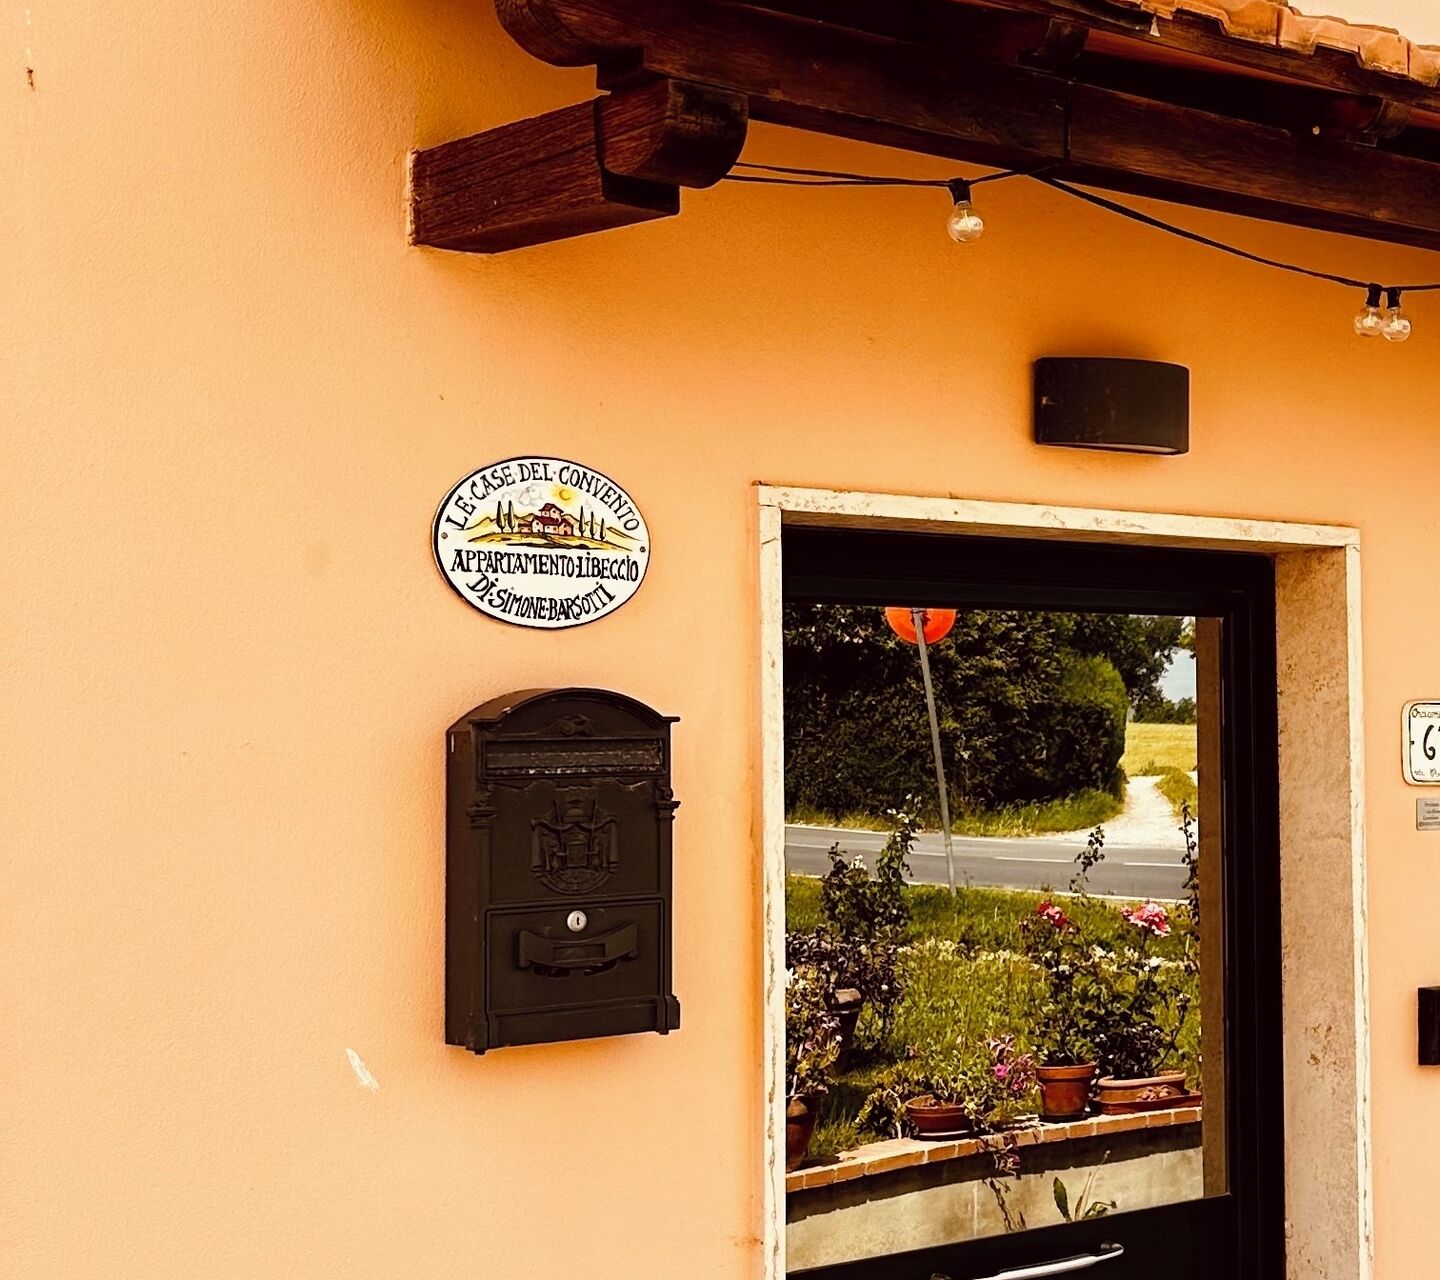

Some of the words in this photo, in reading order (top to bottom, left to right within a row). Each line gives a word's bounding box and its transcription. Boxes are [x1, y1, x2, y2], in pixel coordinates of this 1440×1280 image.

[445, 494, 477, 531] LE
[470, 465, 518, 501] CASE
[517, 462, 553, 483] DEL
[558, 465, 640, 532] CONVENTO
